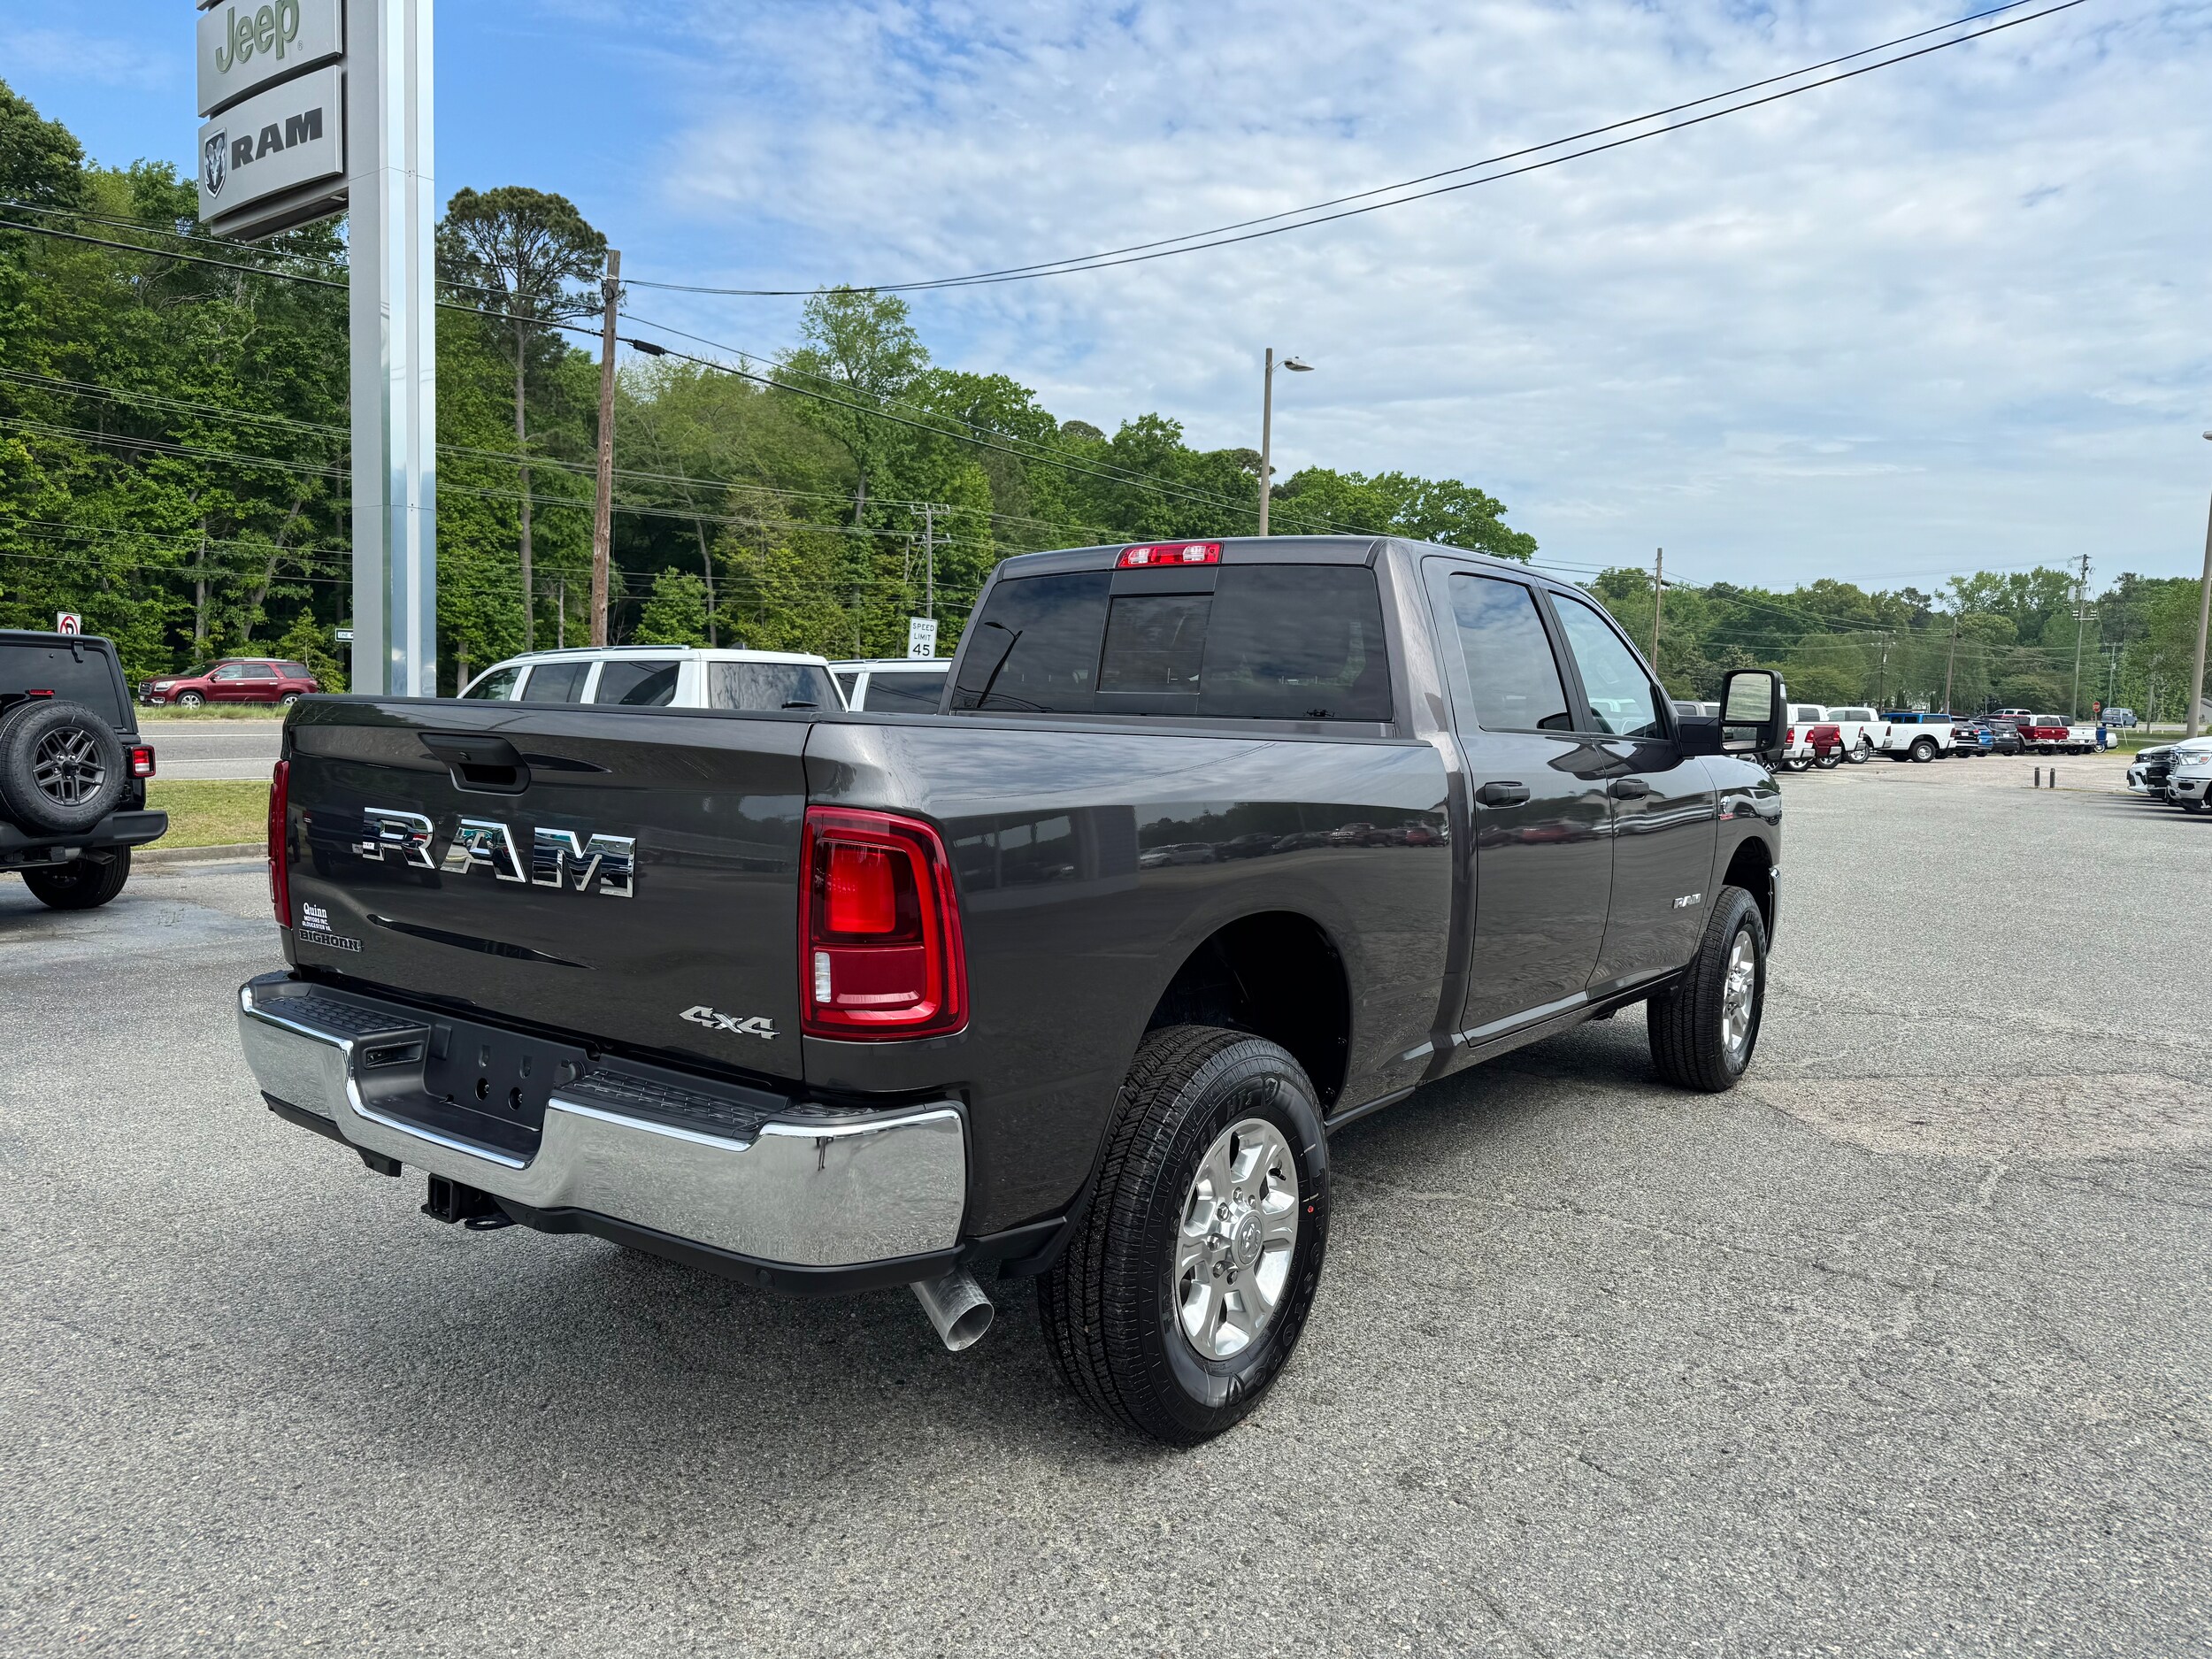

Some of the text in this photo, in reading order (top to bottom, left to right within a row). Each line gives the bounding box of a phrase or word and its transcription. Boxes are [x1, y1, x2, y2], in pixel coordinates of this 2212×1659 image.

[215, 0, 300, 73] Jeep
[231, 107, 323, 171] RAM
[912, 622, 935, 632] SPEED
[913, 633, 932, 641] LIMIT
[912, 643, 931, 657] 45
[362, 807, 637, 898] RAM
[1673, 893, 1701, 910] RAM
[303, 902, 328, 918] Quinn
[303, 915, 320, 924] MOTORS
[299, 928, 361, 953] BIGHORN
